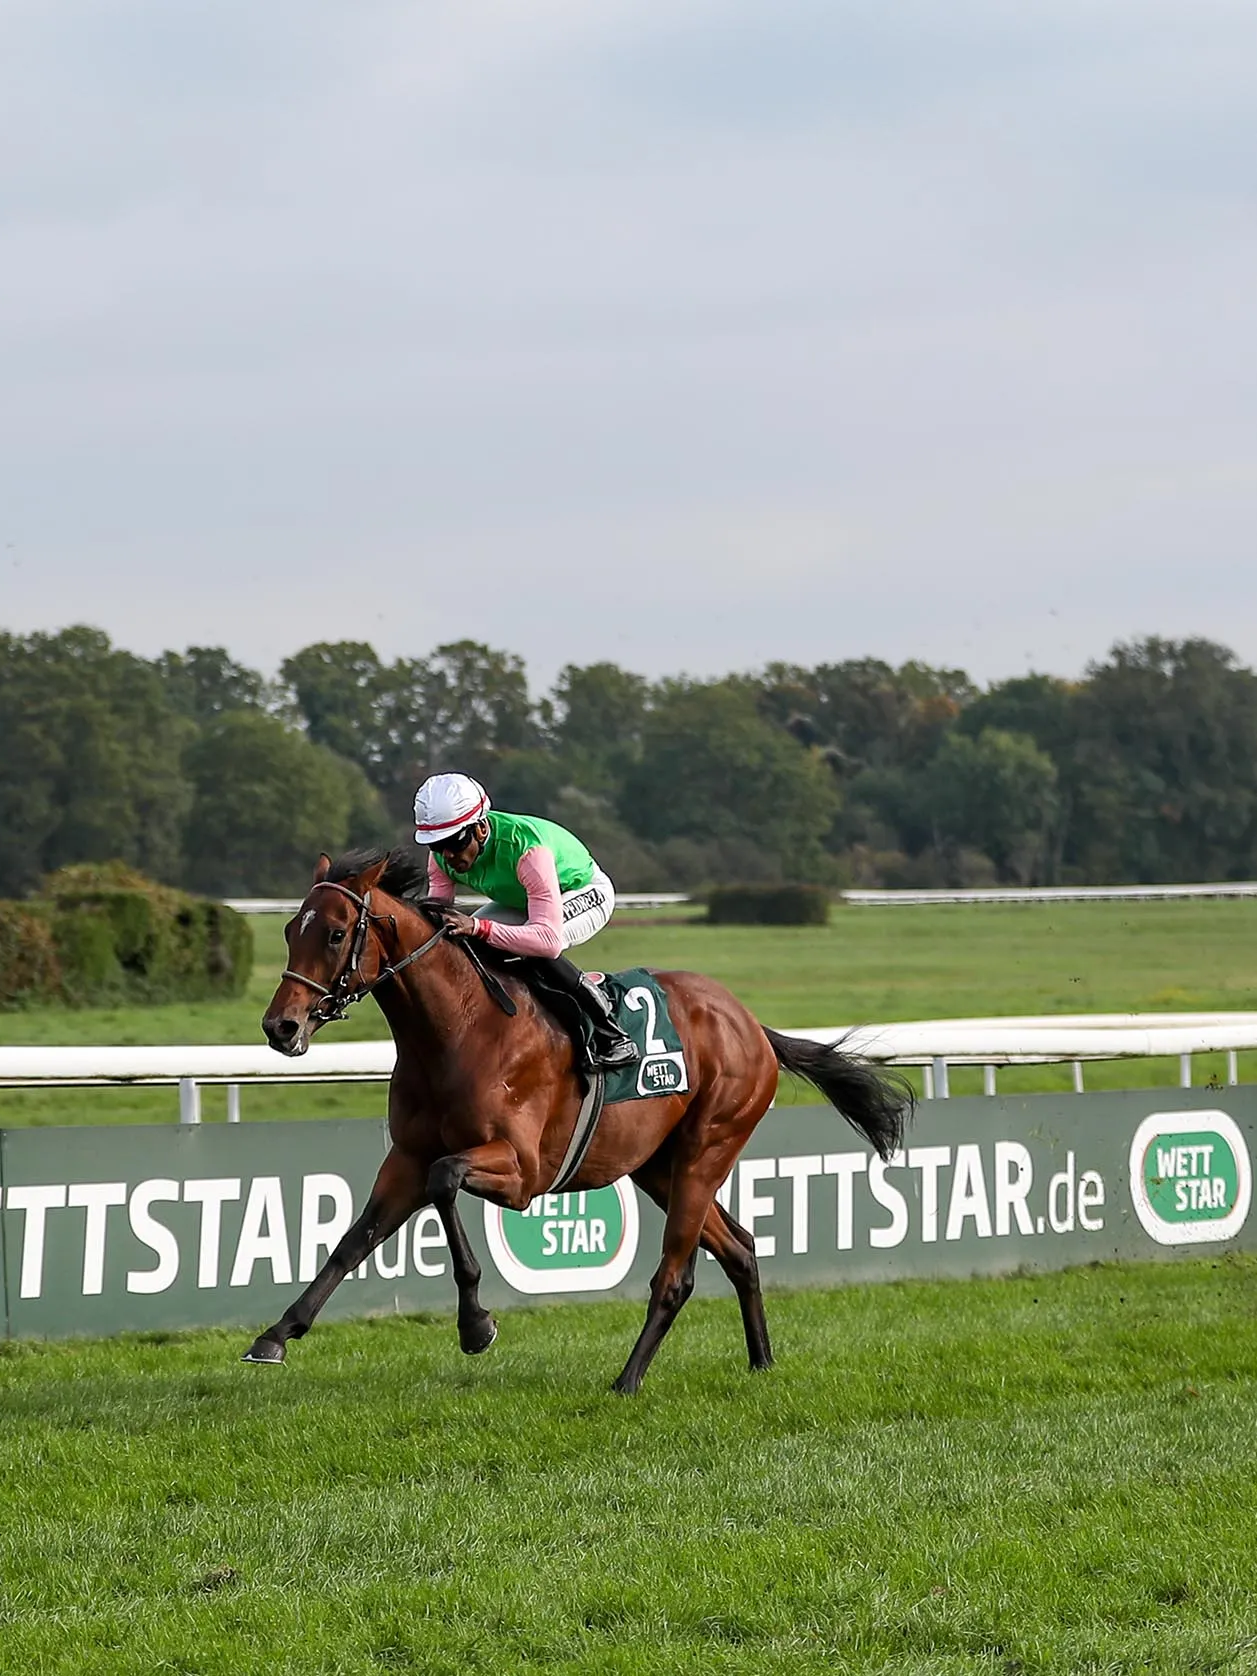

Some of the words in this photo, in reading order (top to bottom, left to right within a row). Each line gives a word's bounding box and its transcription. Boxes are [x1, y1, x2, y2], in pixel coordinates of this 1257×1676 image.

[624, 986, 667, 1055] 2
[646, 1062, 669, 1078] WETT
[653, 1073, 676, 1087] STAR
[1156, 1144, 1215, 1179] WETT
[1174, 1177, 1227, 1211] STAR
[541, 1218, 607, 1257] STAR
